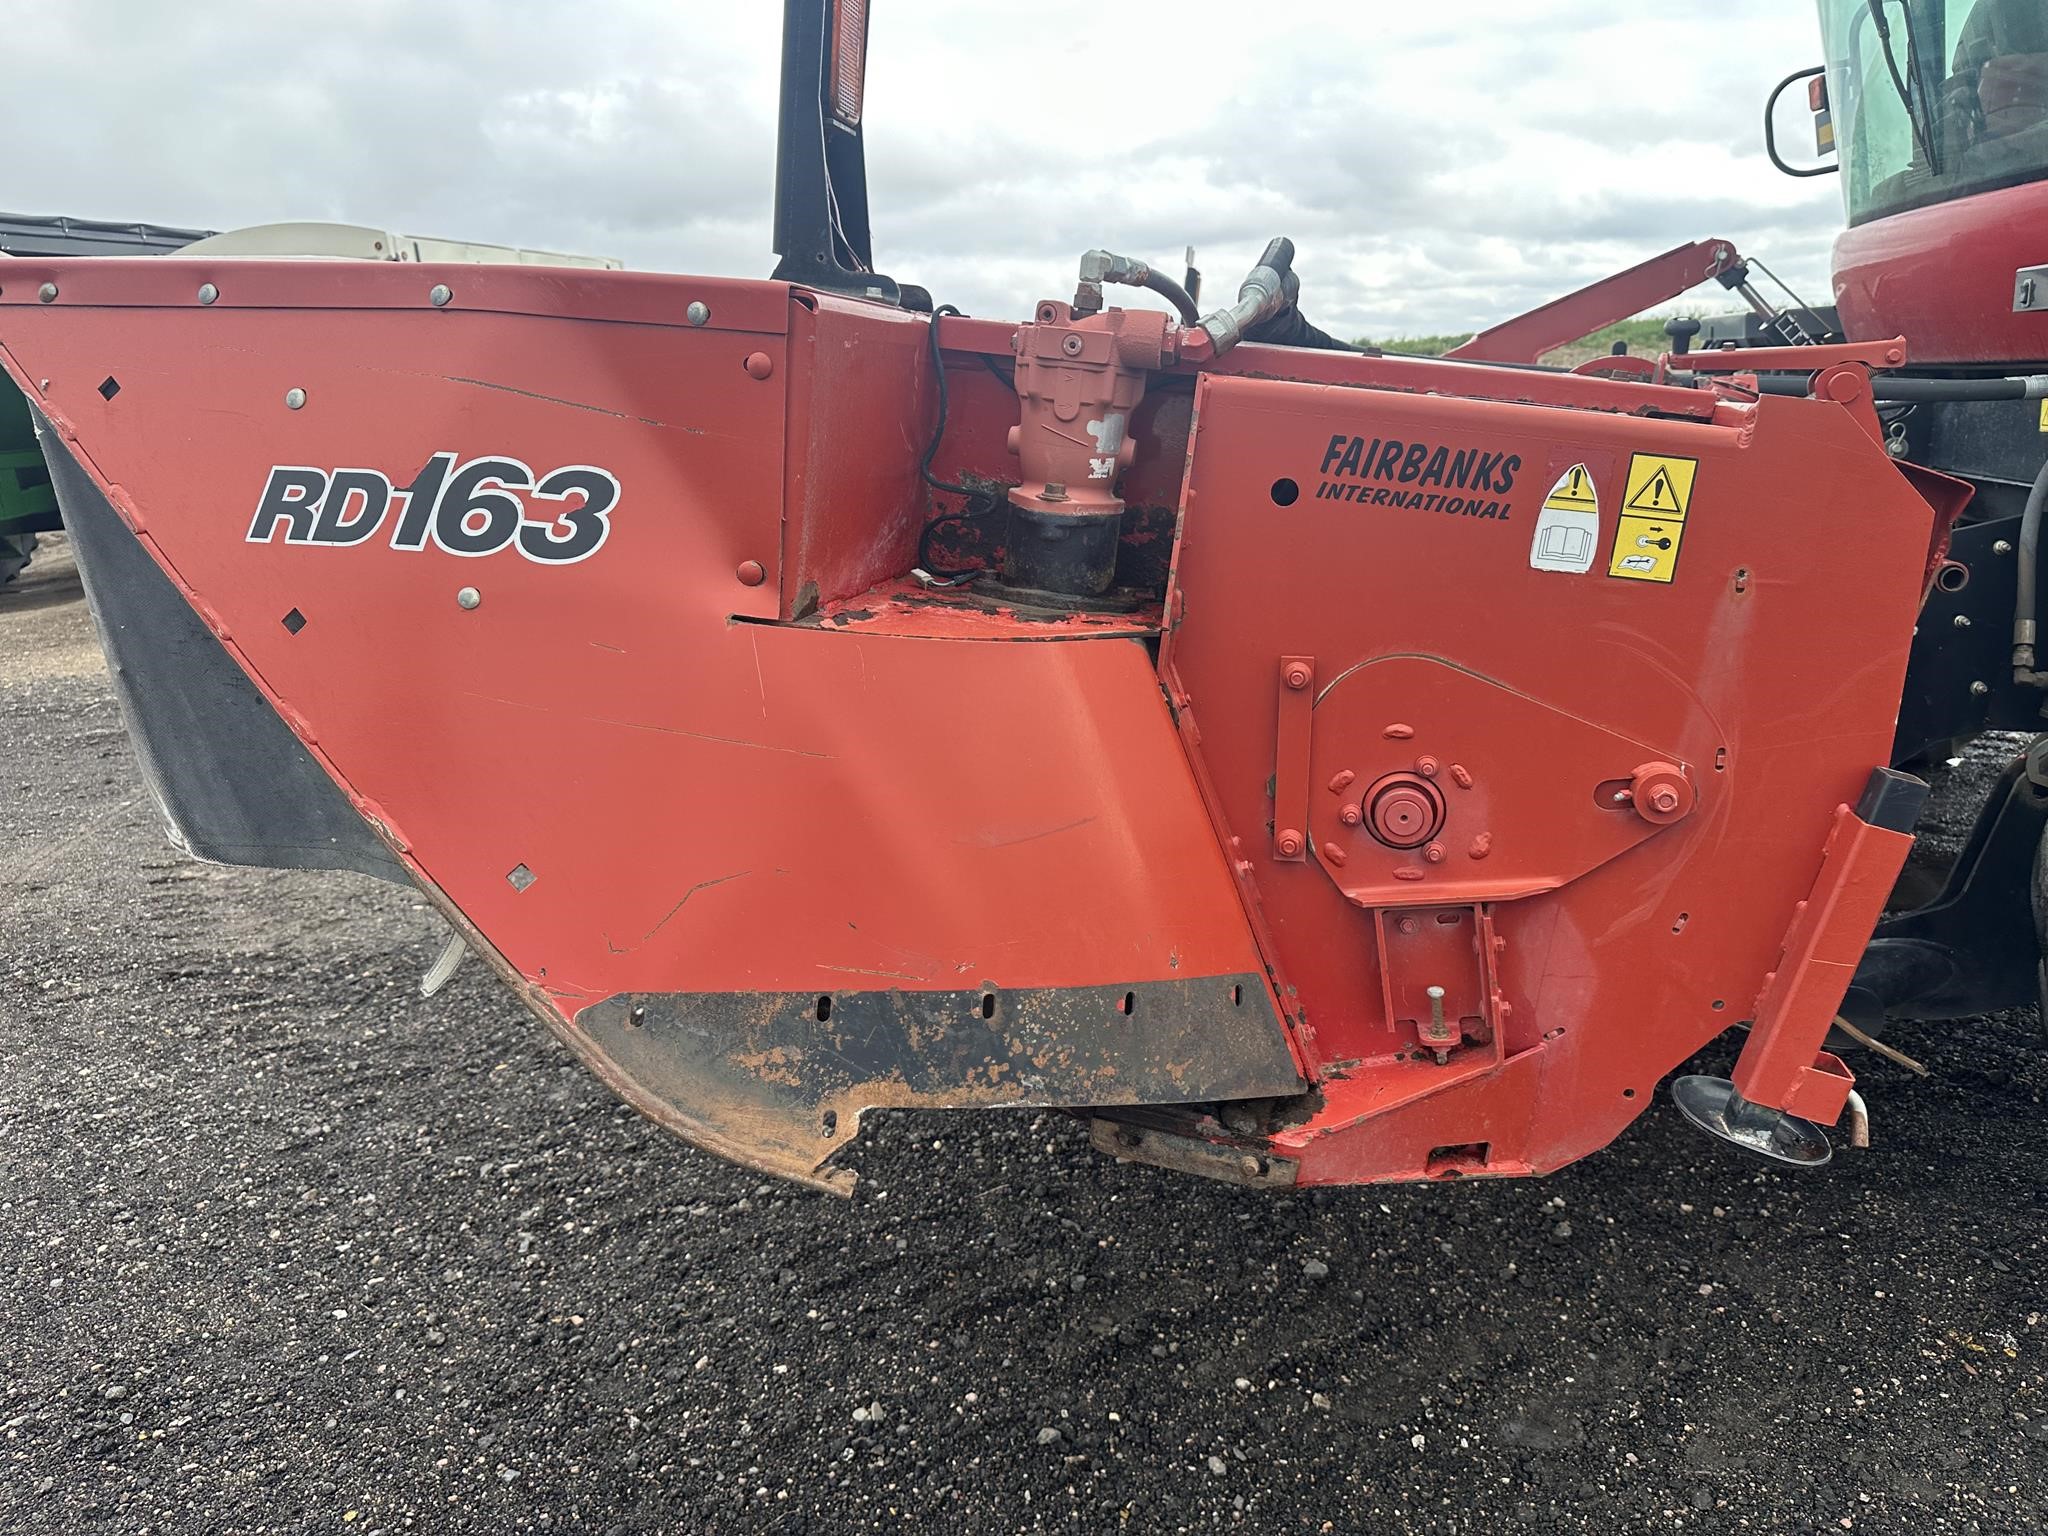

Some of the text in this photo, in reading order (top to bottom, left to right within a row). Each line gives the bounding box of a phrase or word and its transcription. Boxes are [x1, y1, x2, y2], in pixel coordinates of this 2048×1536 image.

[1320, 434, 1522, 495] FAIRBANKS
[245, 451, 621, 565] RD163
[1315, 481, 1511, 520] INTERNATIONAL
